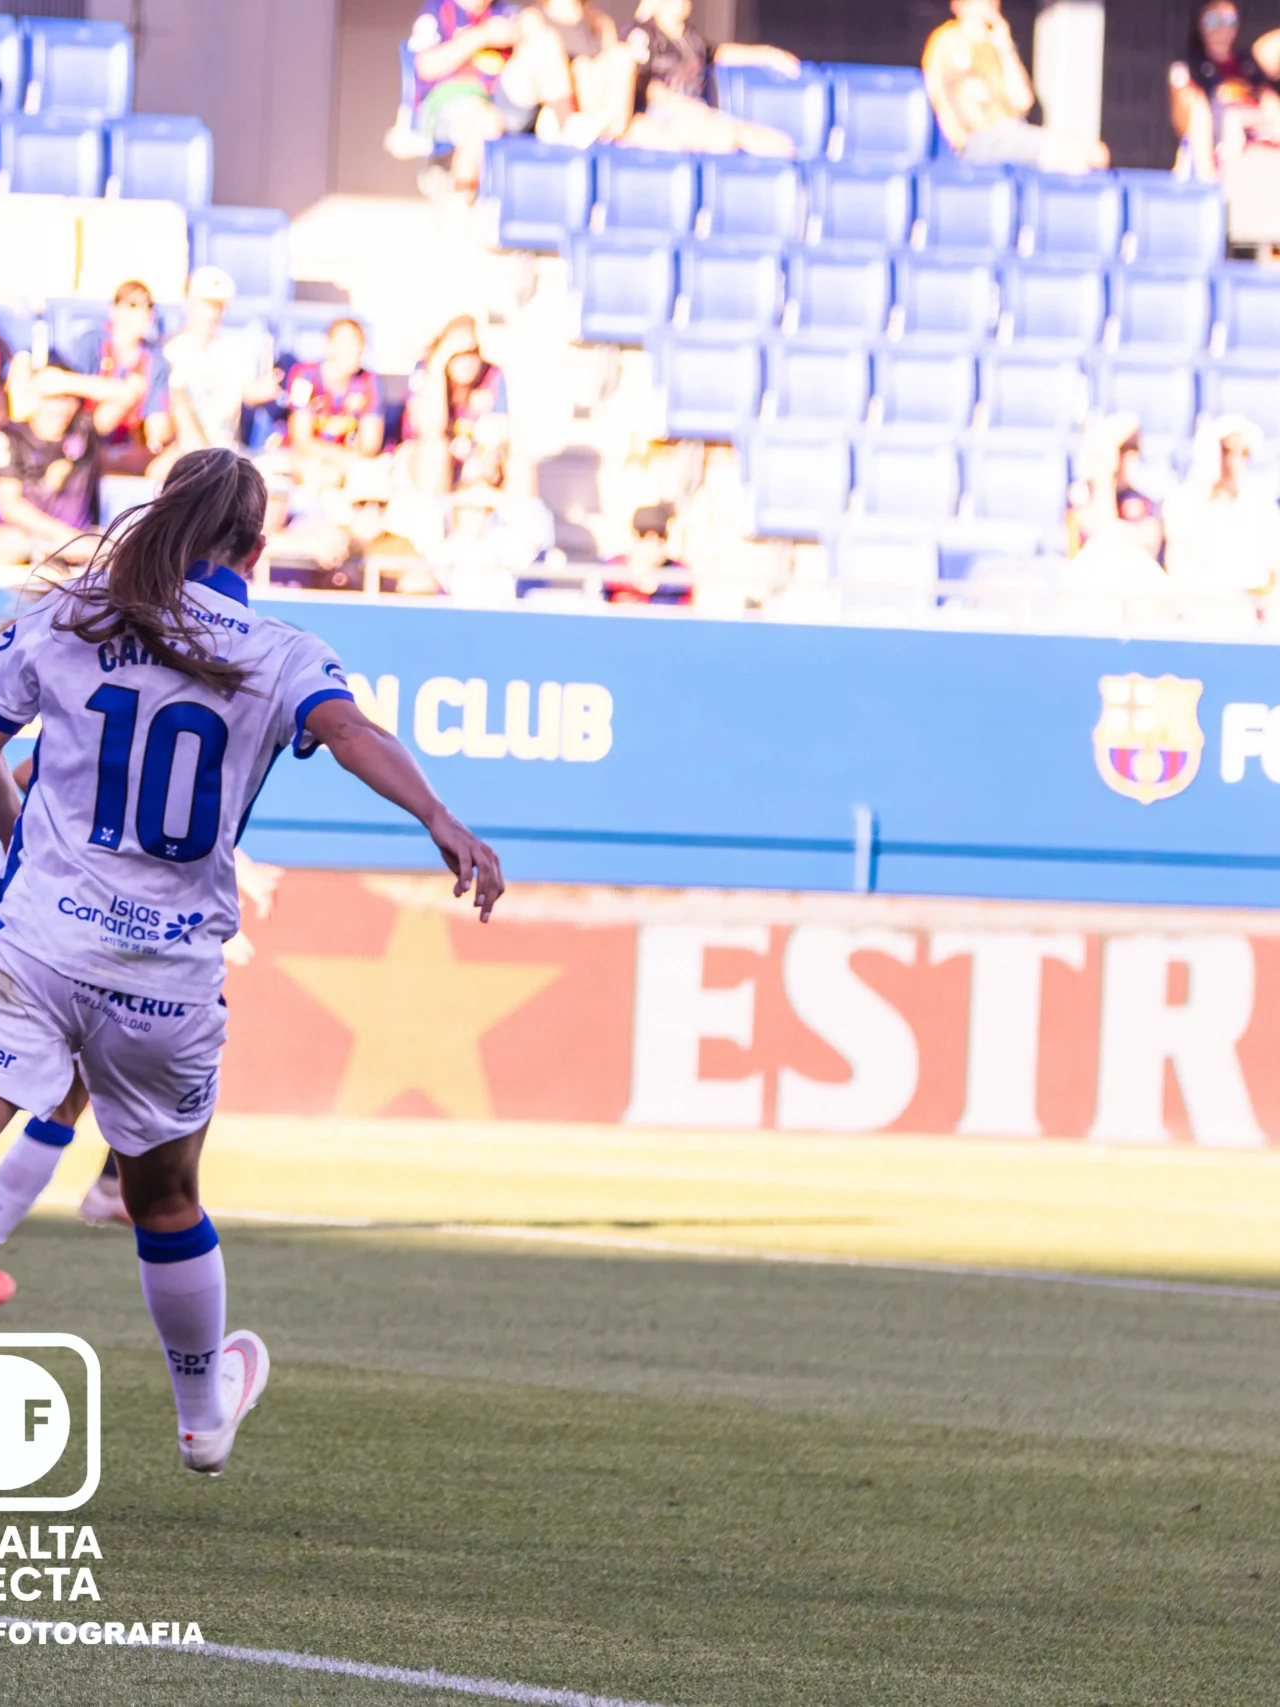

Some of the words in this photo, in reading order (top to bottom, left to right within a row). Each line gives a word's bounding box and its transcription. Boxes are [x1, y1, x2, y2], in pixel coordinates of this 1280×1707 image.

[414, 676, 614, 763] CLUB
[86, 682, 229, 863] 10
[58, 897, 160, 941] Canarias
[110, 895, 161, 927] Islas
[71, 992, 90, 1006] POR
[622, 922, 1269, 1148] ESTR
[168, 1349, 216, 1366] CDT
